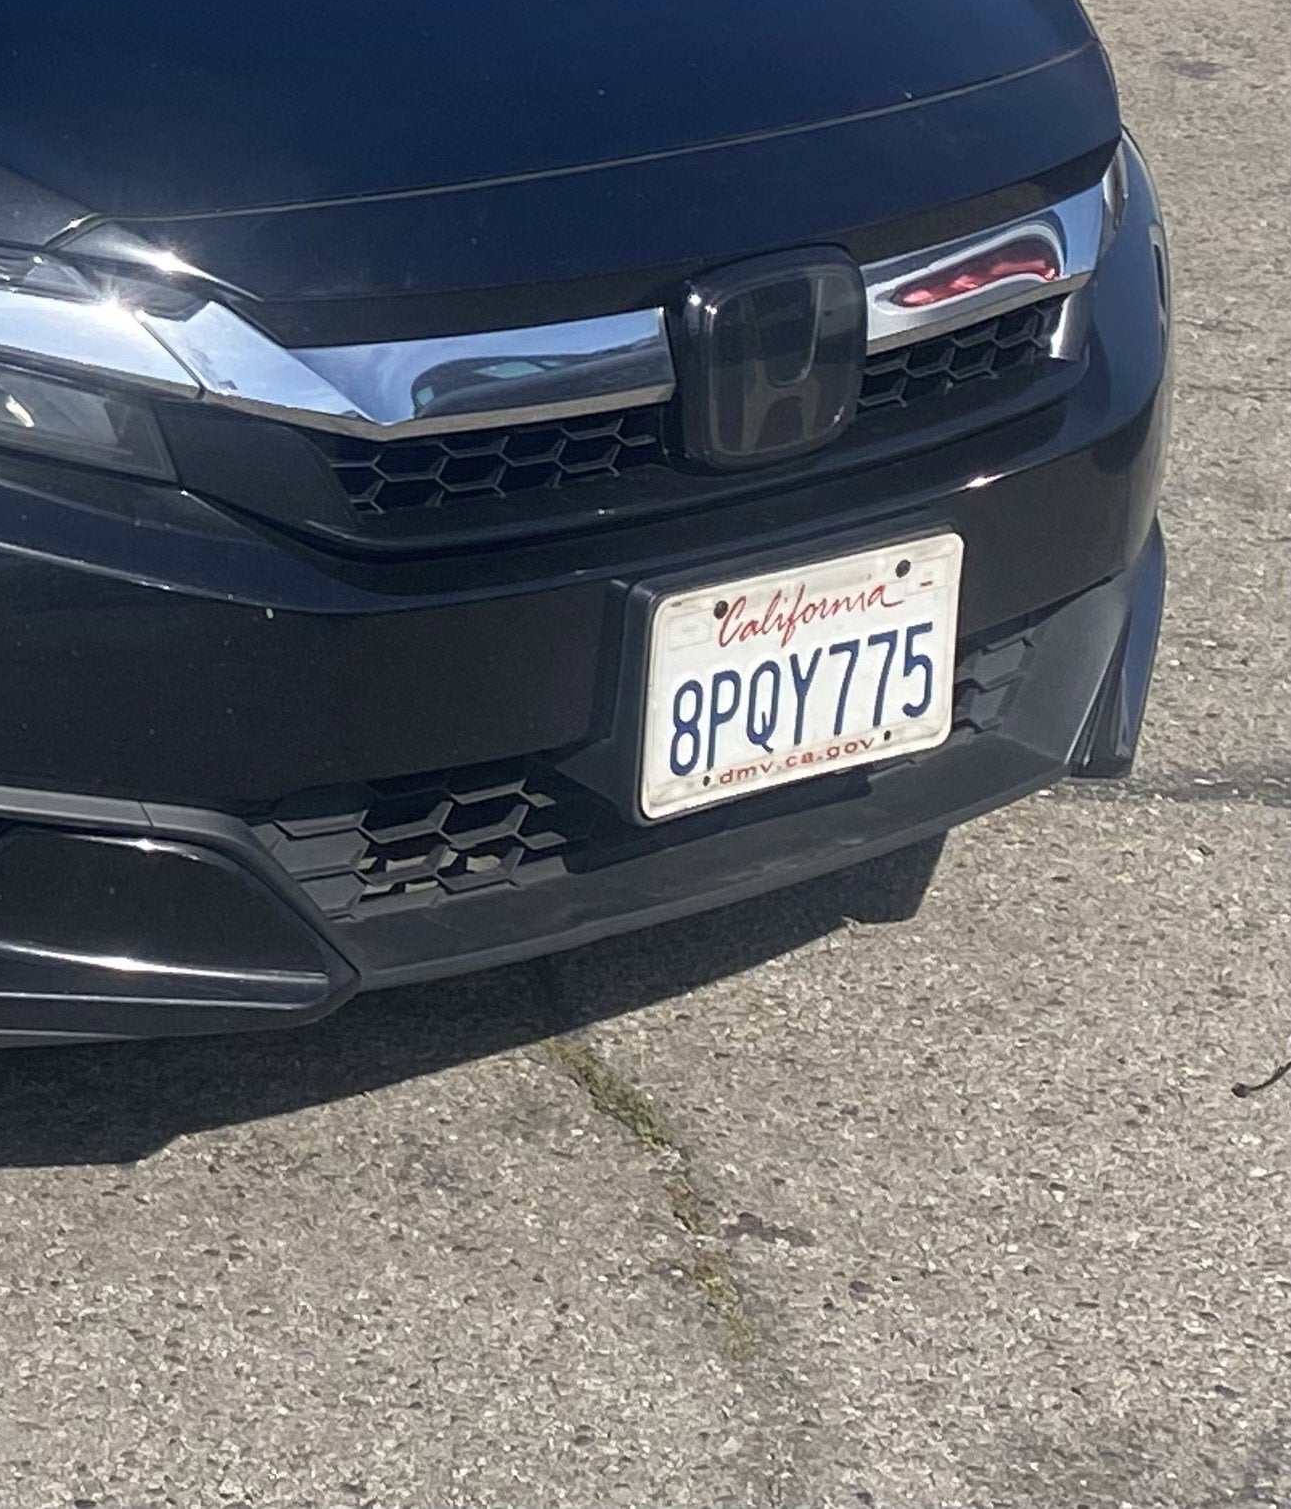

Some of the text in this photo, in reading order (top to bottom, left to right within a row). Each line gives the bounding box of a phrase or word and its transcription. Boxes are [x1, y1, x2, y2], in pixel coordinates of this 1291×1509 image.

[718, 584, 905, 648] California
[669, 621, 933, 777] 8PQY775
[719, 737, 876, 784] dmv.ca.gov
